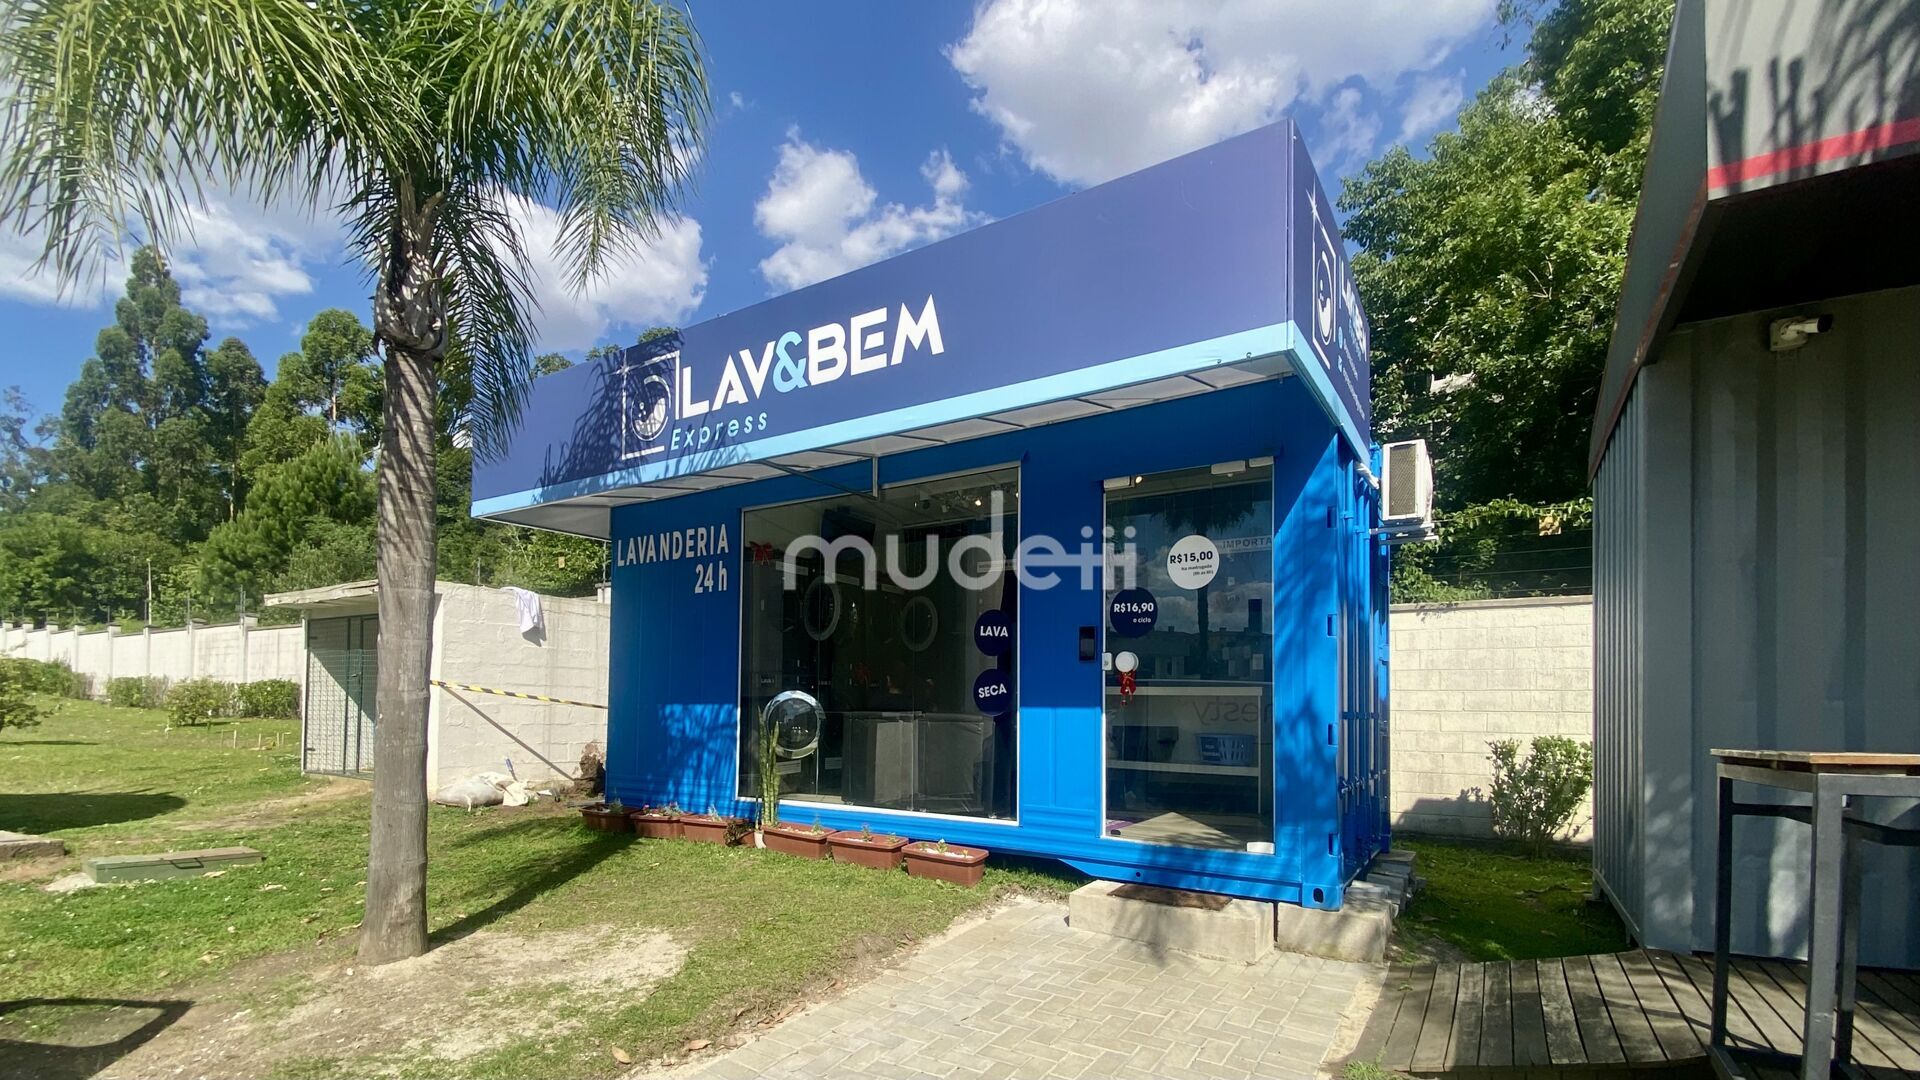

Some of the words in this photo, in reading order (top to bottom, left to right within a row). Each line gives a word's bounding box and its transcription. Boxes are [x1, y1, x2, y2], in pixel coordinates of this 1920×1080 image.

[682, 294, 945, 419] LAV&BEM
[670, 411, 769, 452] Express
[617, 524, 729, 567] LAVANDERIA
[1170, 551, 1213, 564] R$15,00
[694, 562, 714, 594] 24
[718, 560, 728, 592] h
[1113, 602, 1154, 614] R$16,90
[980, 625, 1008, 637] LAVA
[978, 683, 1007, 699] SECA
